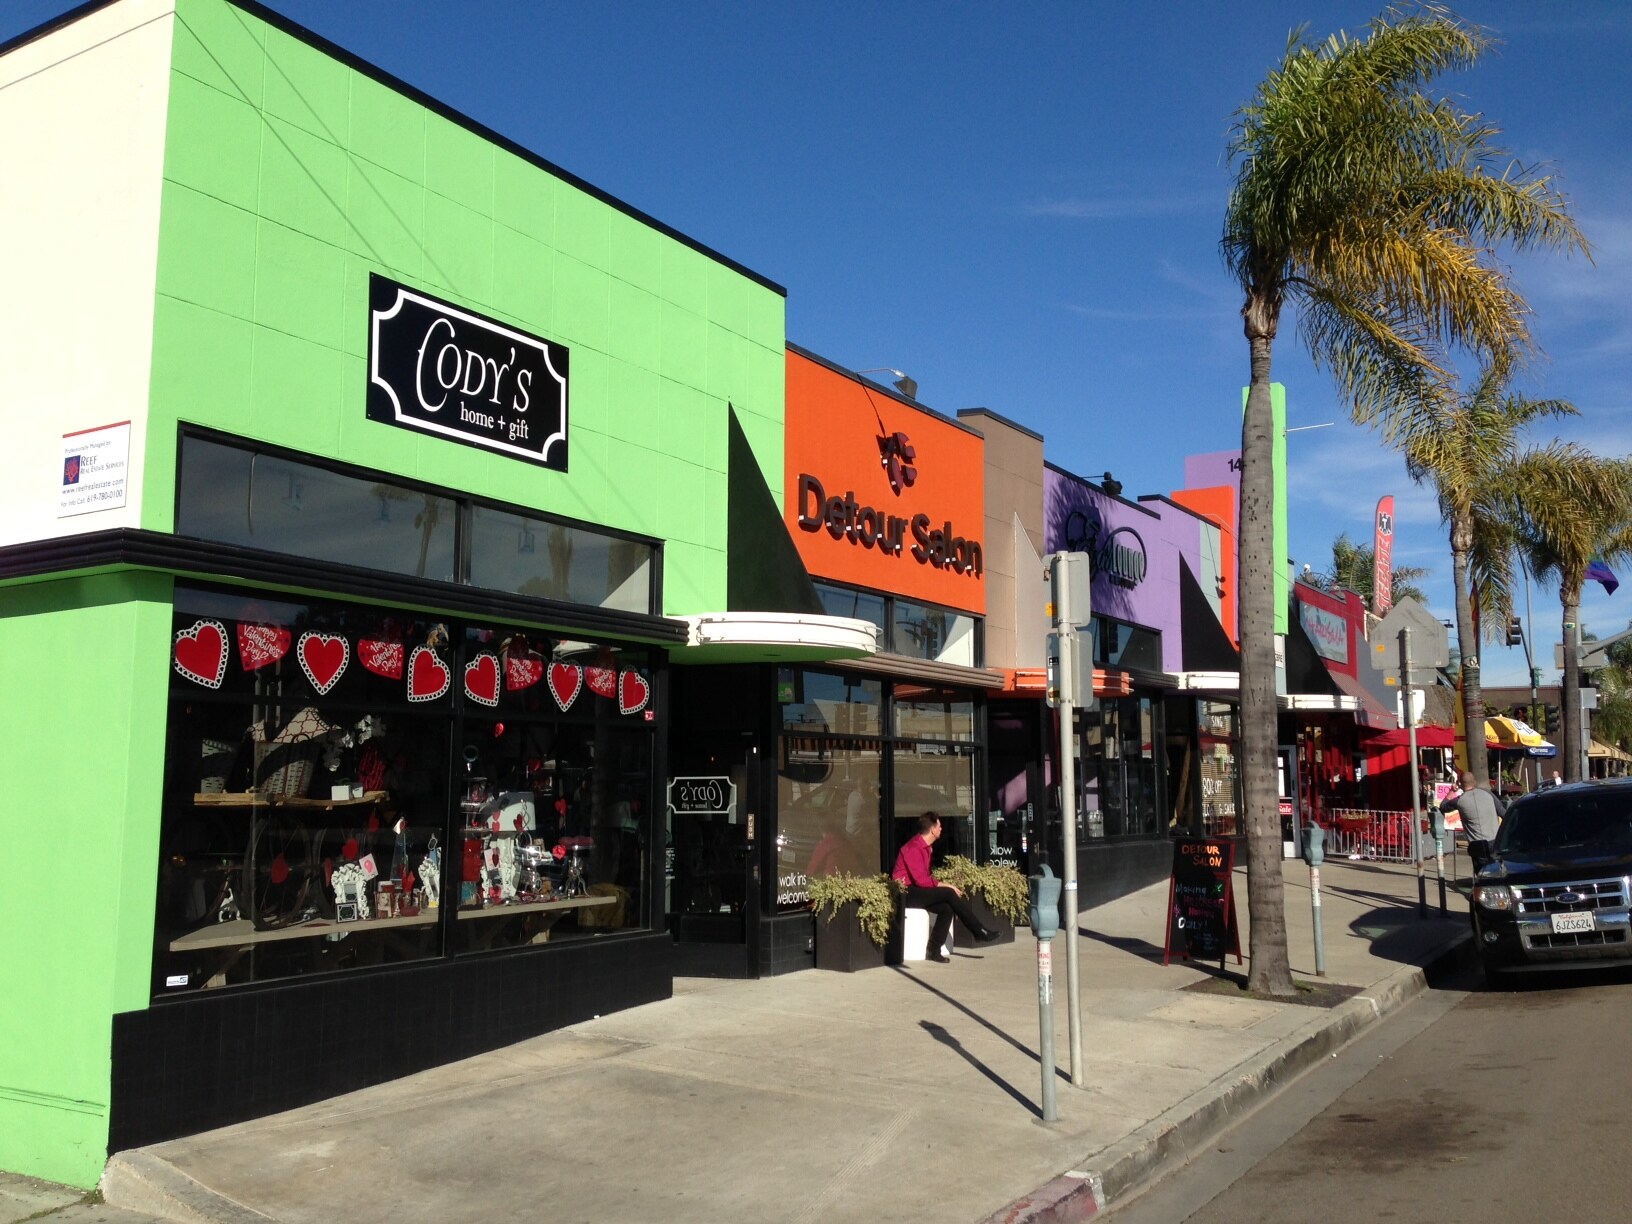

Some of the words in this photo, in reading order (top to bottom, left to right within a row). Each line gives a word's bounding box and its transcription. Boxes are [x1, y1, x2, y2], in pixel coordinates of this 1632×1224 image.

[460, 401, 494, 429] home
[509, 418, 528, 440] gift
[81, 456, 98, 466] REEF
[87, 489, 122, 502] 619-780-0100
[798, 473, 908, 557] Detour
[911, 513, 983, 579] Salon
[779, 872, 796, 887] walk
[798, 872, 806, 886] ins
[777, 890, 810, 904] welcome
[1556, 918, 1592, 930] 6JZS624
